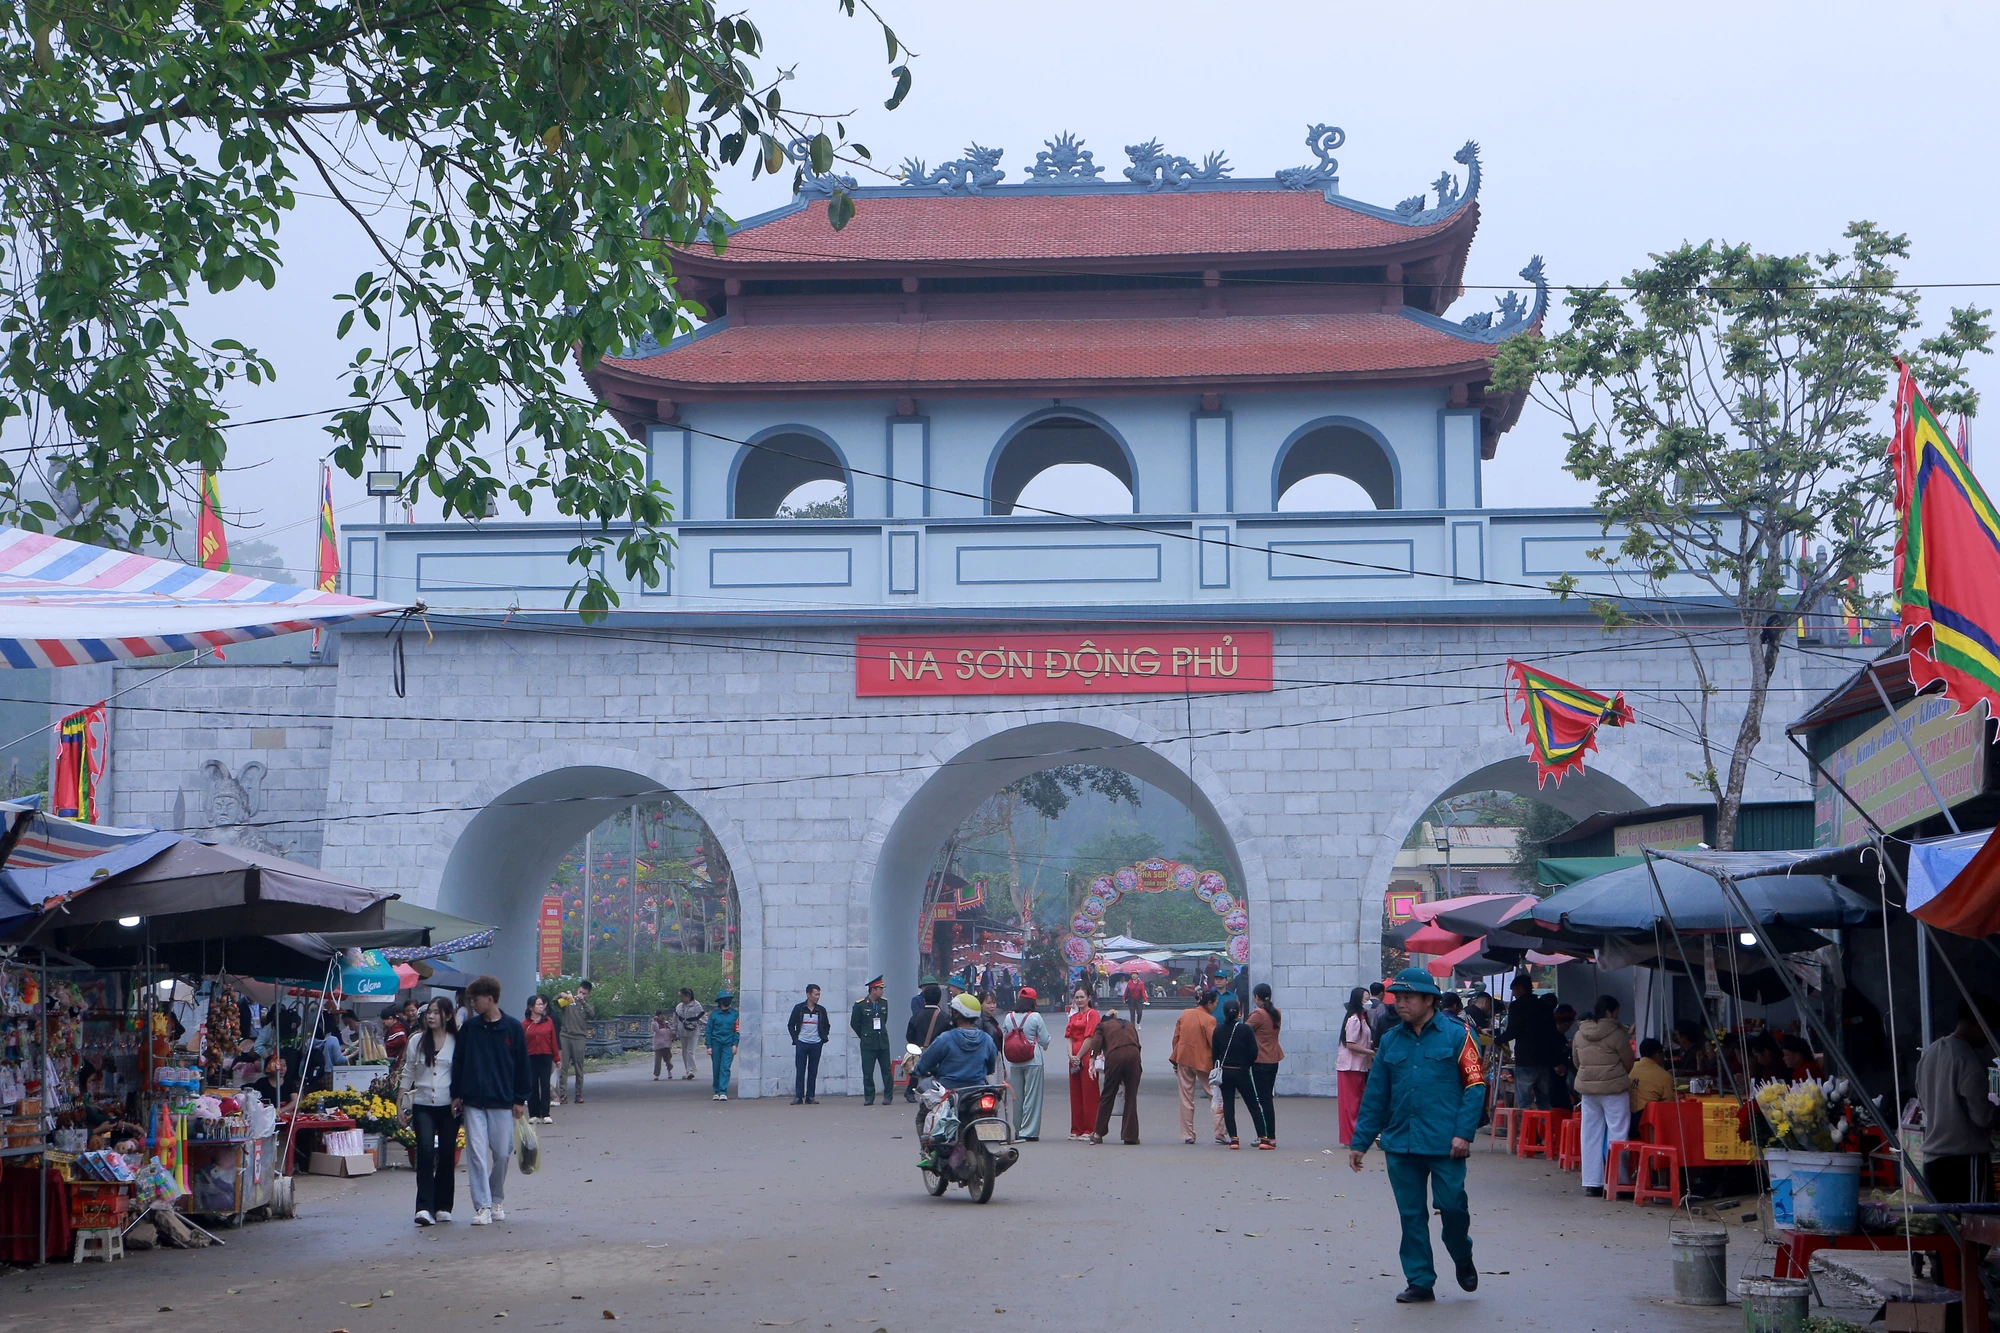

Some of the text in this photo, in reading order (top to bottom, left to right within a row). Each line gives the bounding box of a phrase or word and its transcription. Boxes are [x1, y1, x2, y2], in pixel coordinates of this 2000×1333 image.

[888, 635, 1239, 685] NA SƠN ĐỘNG PHỦ
